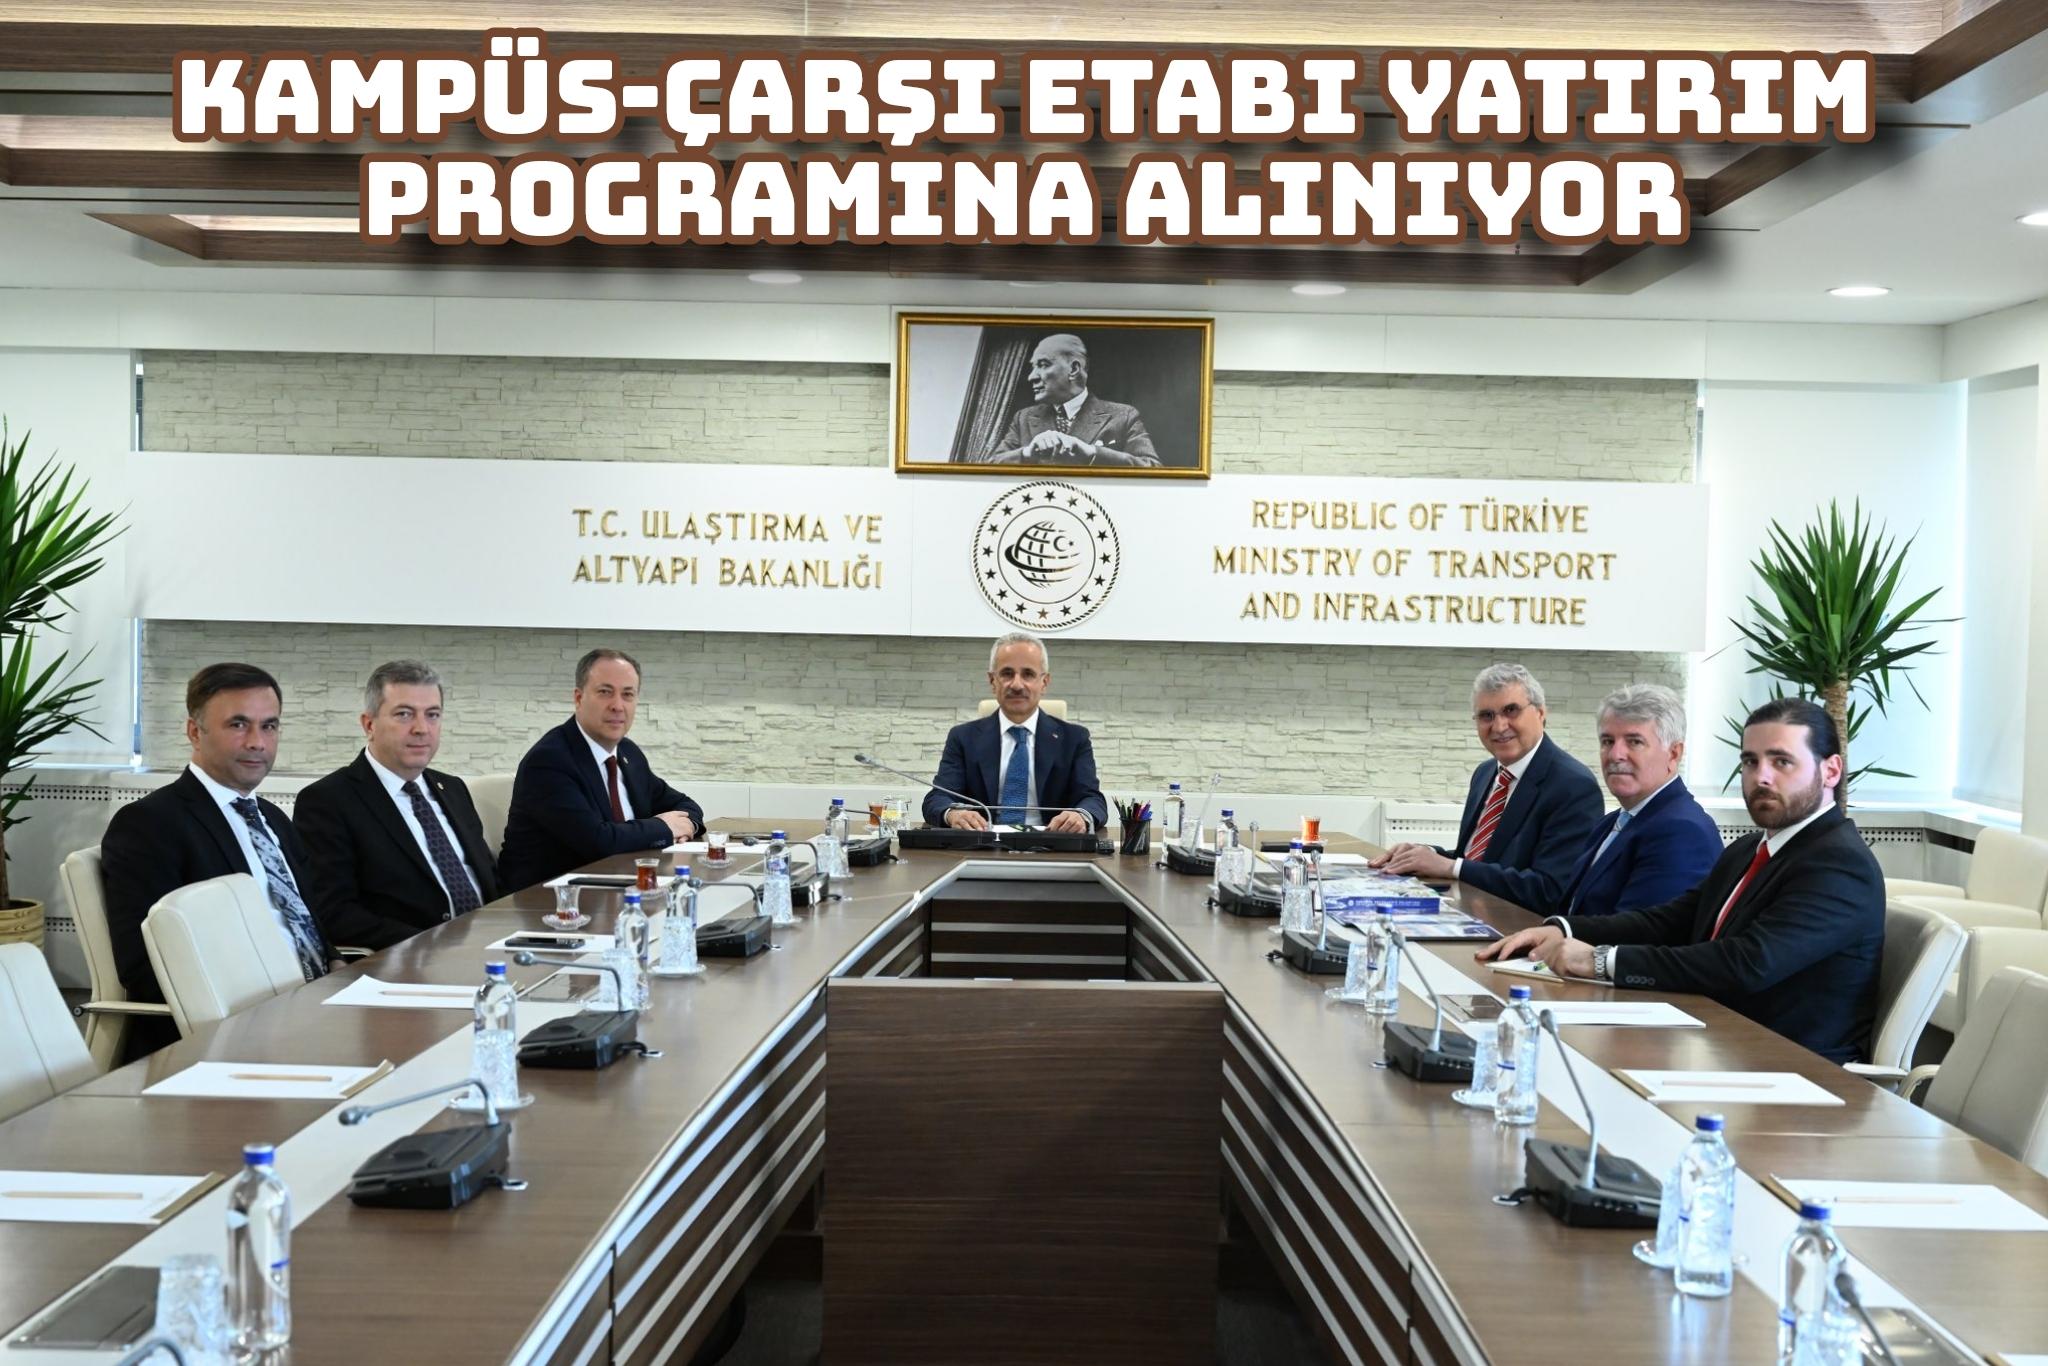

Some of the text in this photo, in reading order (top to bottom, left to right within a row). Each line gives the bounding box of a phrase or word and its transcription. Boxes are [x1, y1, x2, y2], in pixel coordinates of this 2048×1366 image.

[572, 509, 883, 545] T.C. ULAŞTIRMA VE
[1251, 497, 1589, 534] REPUBLIC OF TÜRKİYE
[572, 553, 883, 589] ALTYAPI BAKANLIĞI
[1212, 546, 1618, 581] MINISTRY OF TRANSPORT
[1240, 592, 1588, 626] AND INFRASTRUCTURE
